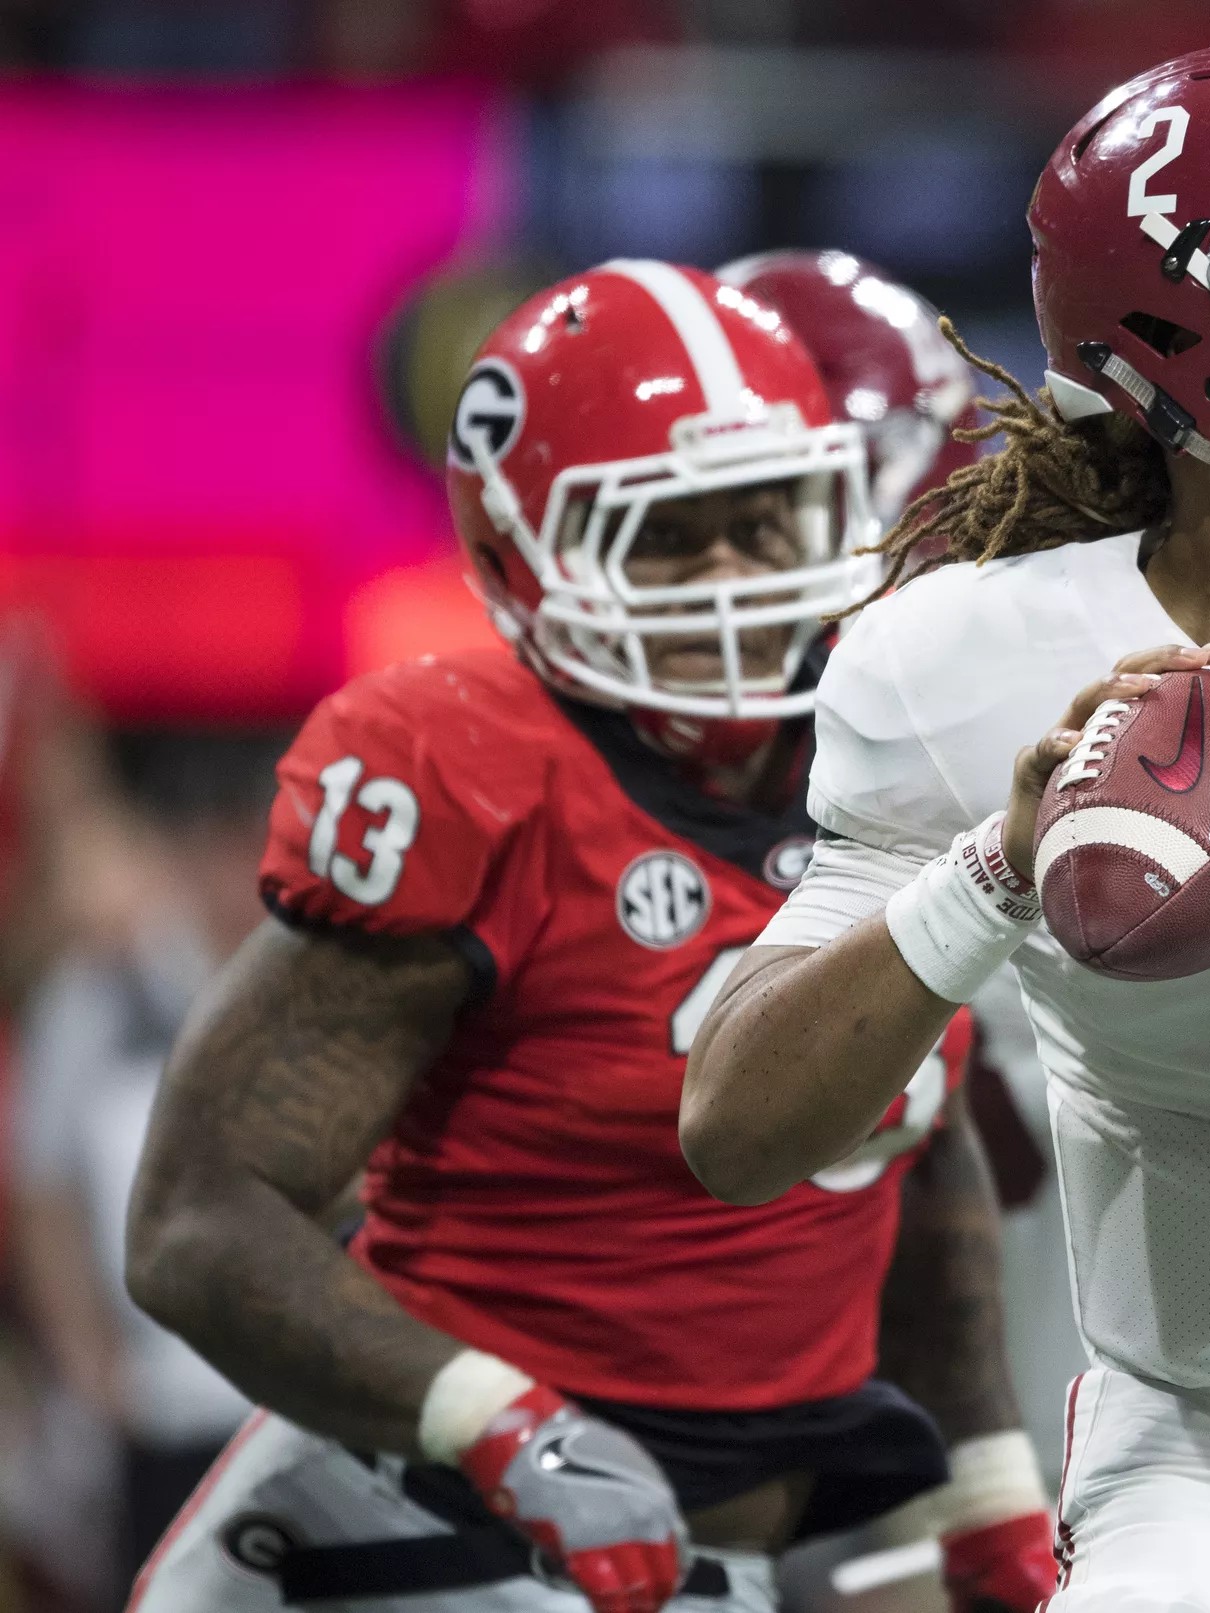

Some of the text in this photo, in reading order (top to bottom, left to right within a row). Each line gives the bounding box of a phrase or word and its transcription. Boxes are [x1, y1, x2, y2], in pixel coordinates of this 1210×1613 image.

[1127, 104, 1191, 218] 2
[450, 364, 518, 468] G
[308, 755, 421, 907] 13
[622, 857, 704, 940] SEC
